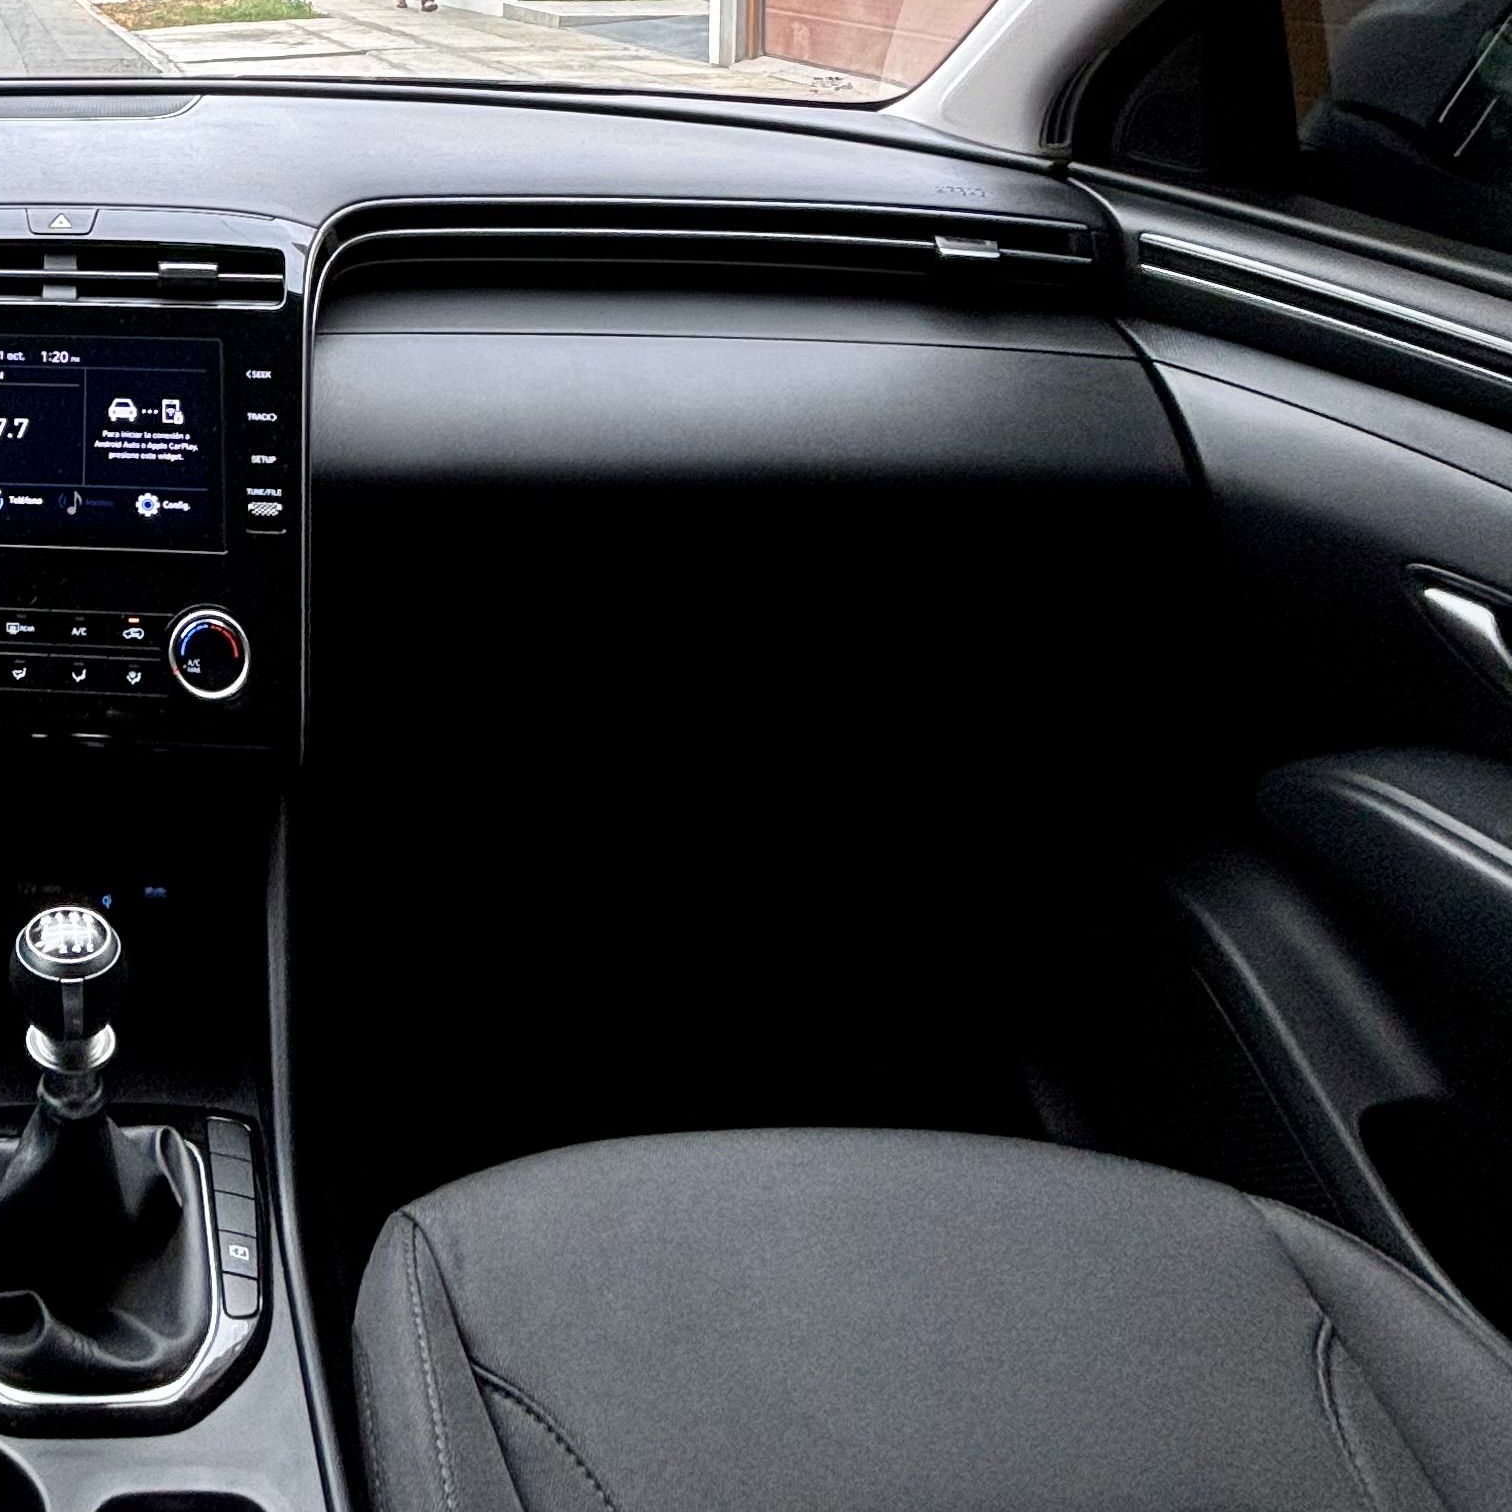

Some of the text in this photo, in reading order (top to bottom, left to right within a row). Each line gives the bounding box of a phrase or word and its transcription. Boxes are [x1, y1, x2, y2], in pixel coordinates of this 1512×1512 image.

[40, 350, 69, 363] 1:20
[251, 455, 277, 464] SETUP
[71, 627, 87, 636] A/C
[187, 659, 201, 667] A/C
